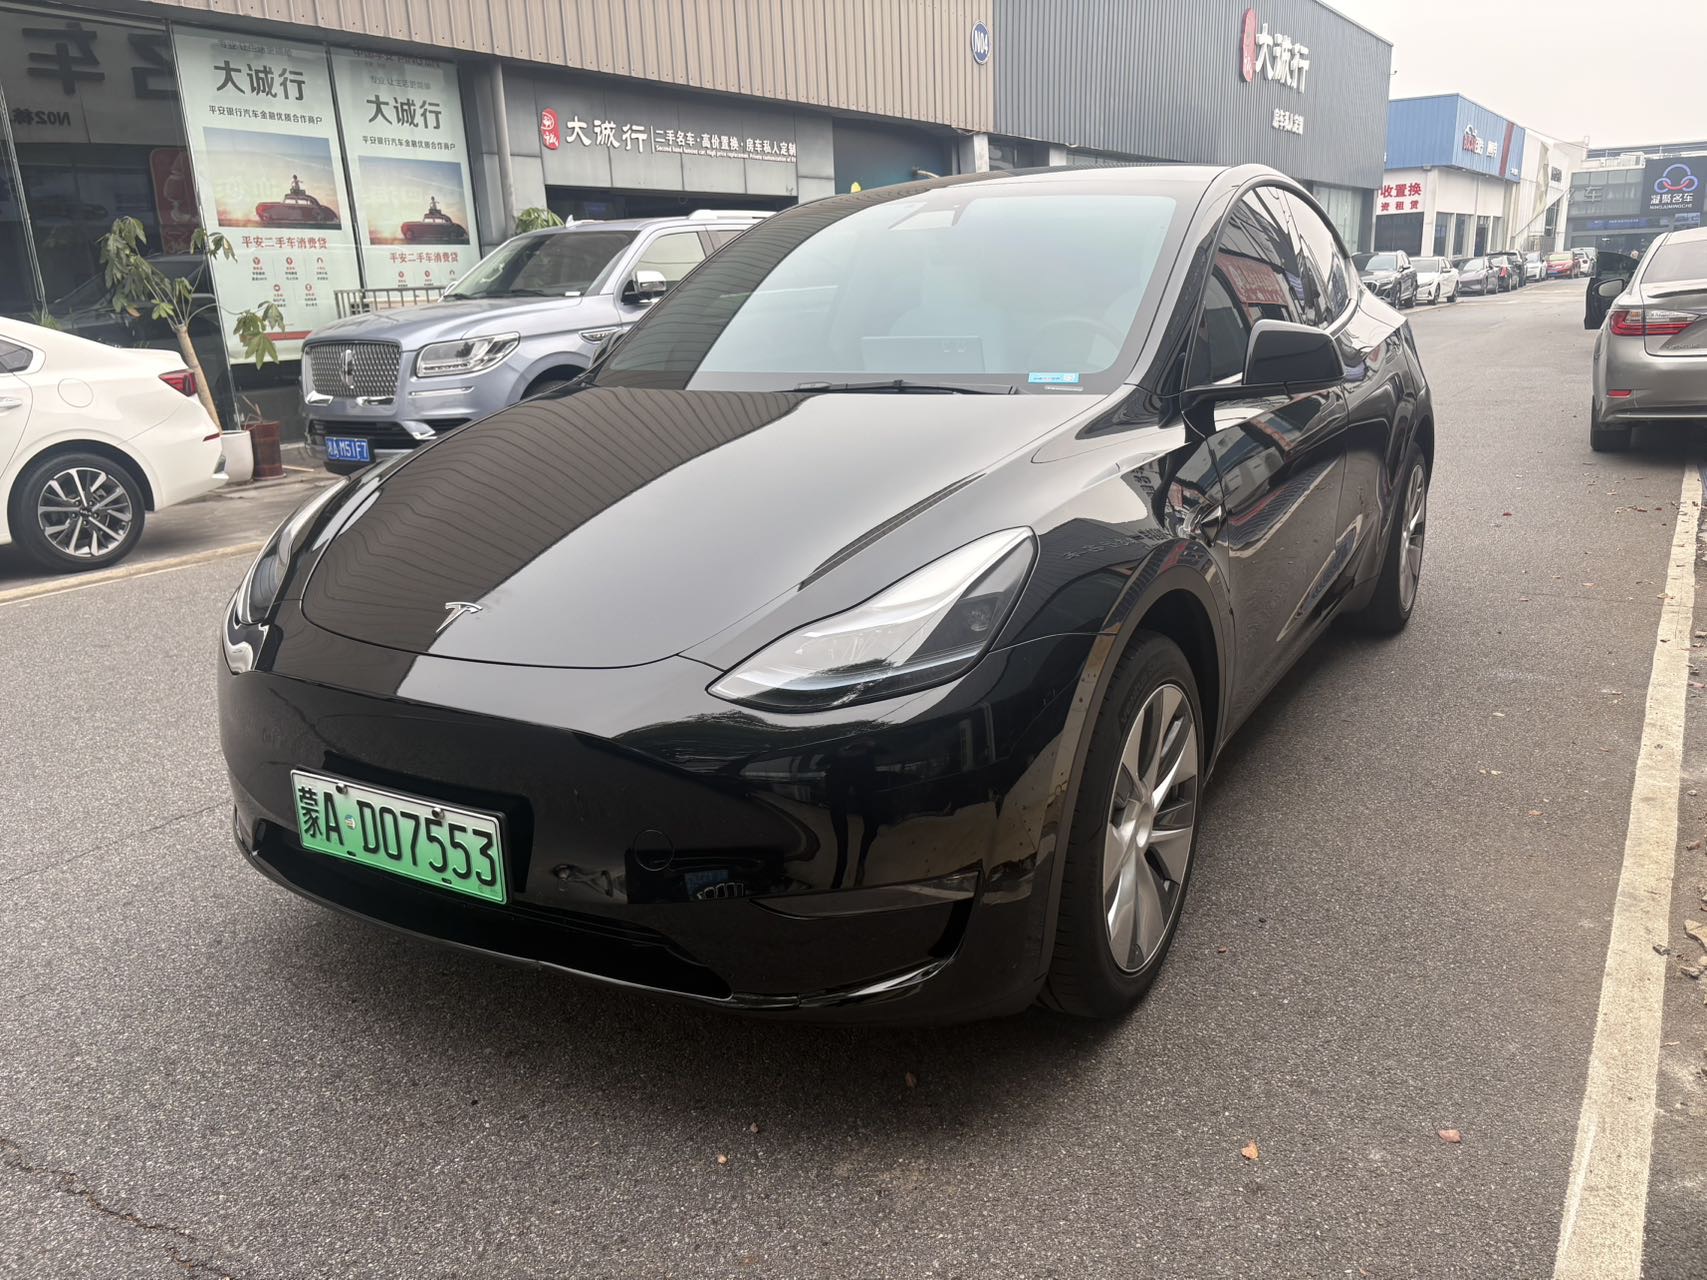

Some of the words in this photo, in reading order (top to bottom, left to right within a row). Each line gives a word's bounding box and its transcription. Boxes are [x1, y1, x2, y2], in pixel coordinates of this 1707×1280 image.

[1256, 23, 1309, 93] 大诚行
[213, 60, 305, 101] 大诚行
[208, 104, 323, 125] 平安银行汽车金融优质合作商户
[366, 94, 442, 130] 大诚行
[566, 115, 648, 153] 大诚行
[1650, 193, 1693, 204] 凝聚名车
[242, 235, 328, 249] 平安二手车消费贷
[390, 252, 458, 263] 平安二手车消费贷
